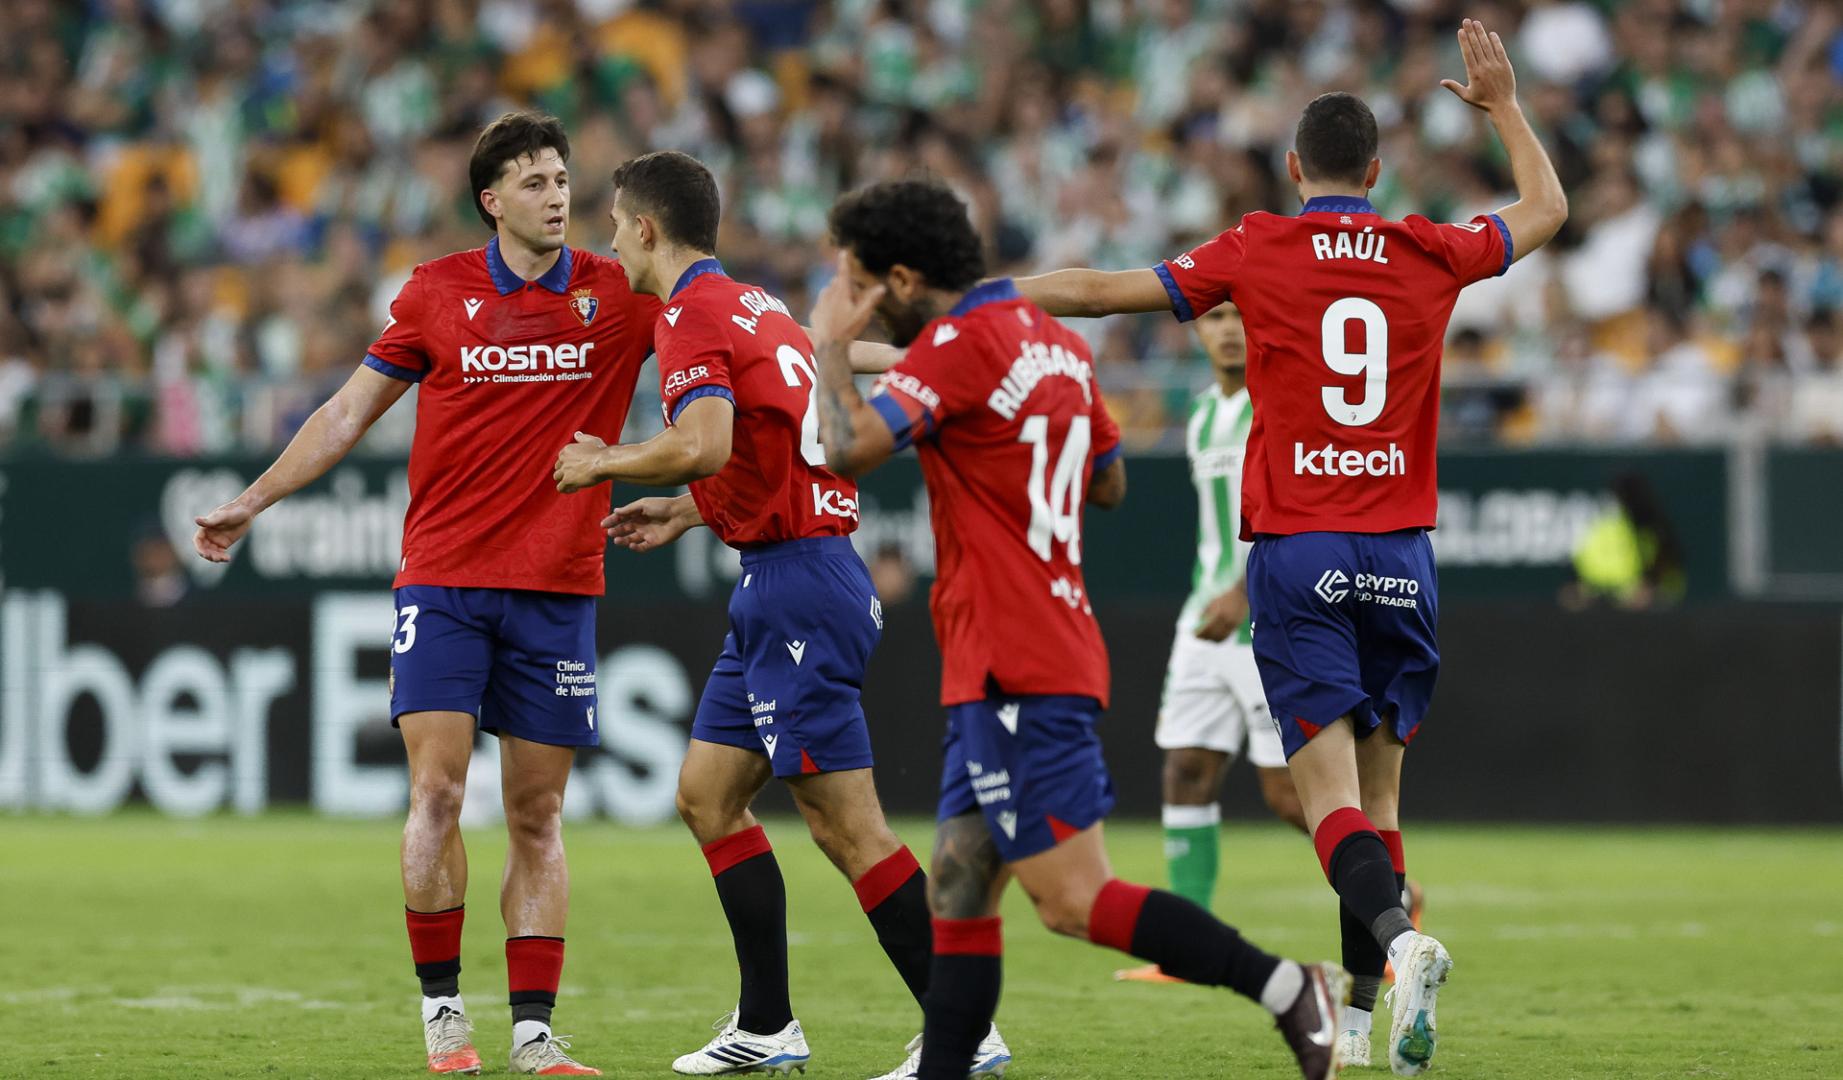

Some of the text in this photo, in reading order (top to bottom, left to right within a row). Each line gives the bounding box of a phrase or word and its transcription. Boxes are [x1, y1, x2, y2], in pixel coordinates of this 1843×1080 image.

[1312, 227, 1388, 264] RAÚL
[731, 314, 758, 335] A.
[493, 370, 592, 383] Climatización eficiente
[1322, 297, 1388, 427] 9
[1294, 442, 1405, 477] ktech
[1018, 415, 1090, 565] 14
[1375, 594, 1417, 609] TRADER
[390, 605, 420, 654] 3
[555, 685, 569, 696] de
